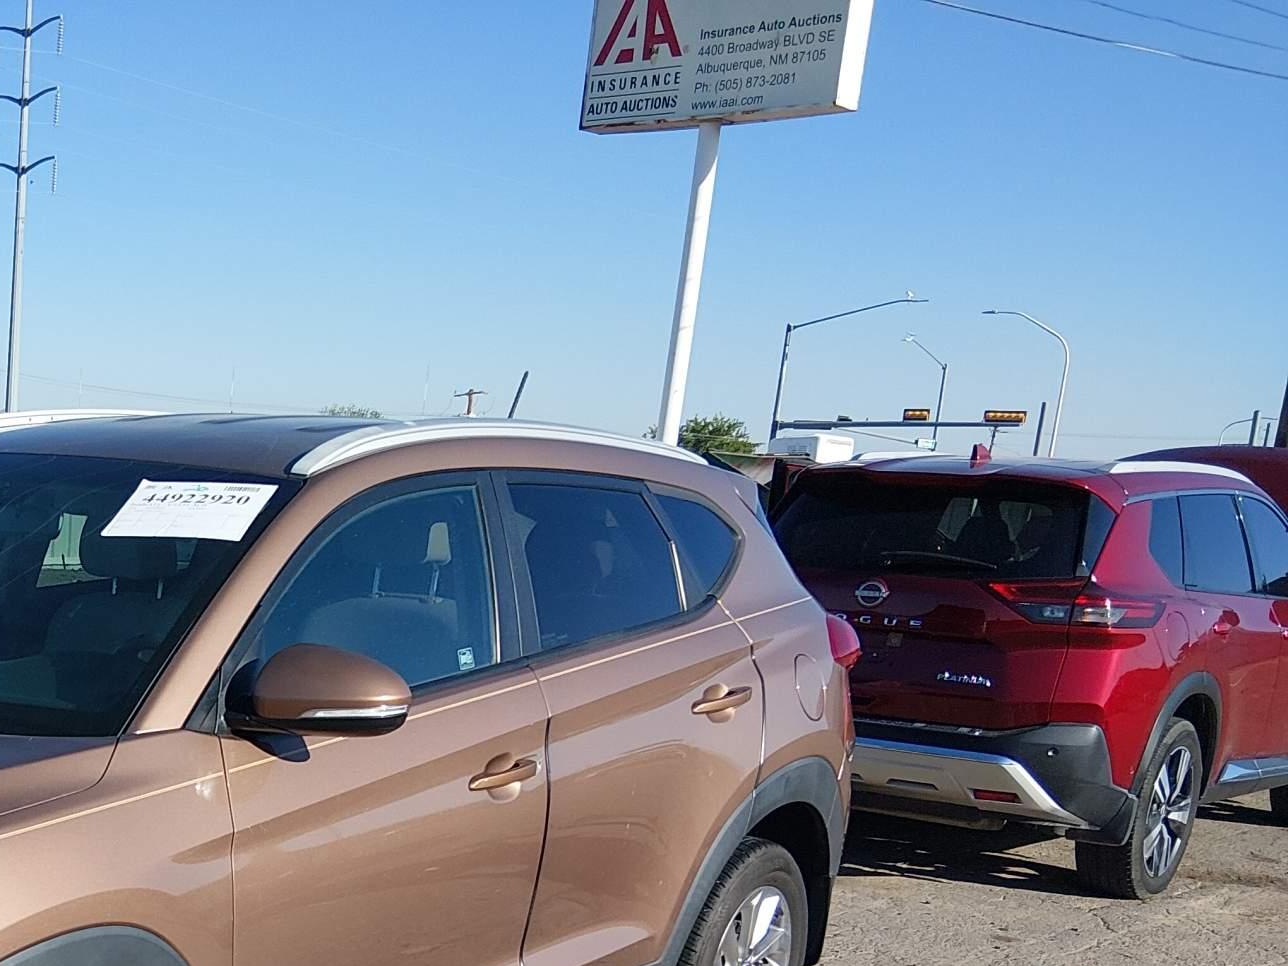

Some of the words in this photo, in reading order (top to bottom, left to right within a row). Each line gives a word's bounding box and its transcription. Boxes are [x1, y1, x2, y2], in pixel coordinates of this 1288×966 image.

[700, 24, 755, 41] Insurance
[758, 20, 786, 33] Auto
[788, 13, 842, 29] Auctions
[698, 43, 724, 56] 4400
[727, 36, 779, 54] Broadway
[783, 32, 815, 47] BLVD
[818, 29, 836, 42] SE
[696, 57, 765, 75] Albuquerque,
[769, 53, 789, 66] NM
[791, 49, 826, 64] 87105
[590, 72, 681, 93] INSURANCE
[694, 80, 712, 94] Ph:
[715, 78, 743, 94] (505)
[746, 72, 796, 89] 873-2081
[587, 101, 618, 116] AUTO
[620, 95, 679, 113] AUCTIONS
[691, 95, 763, 110] www.iaai.com
[142, 492, 251, 505] 44922920
